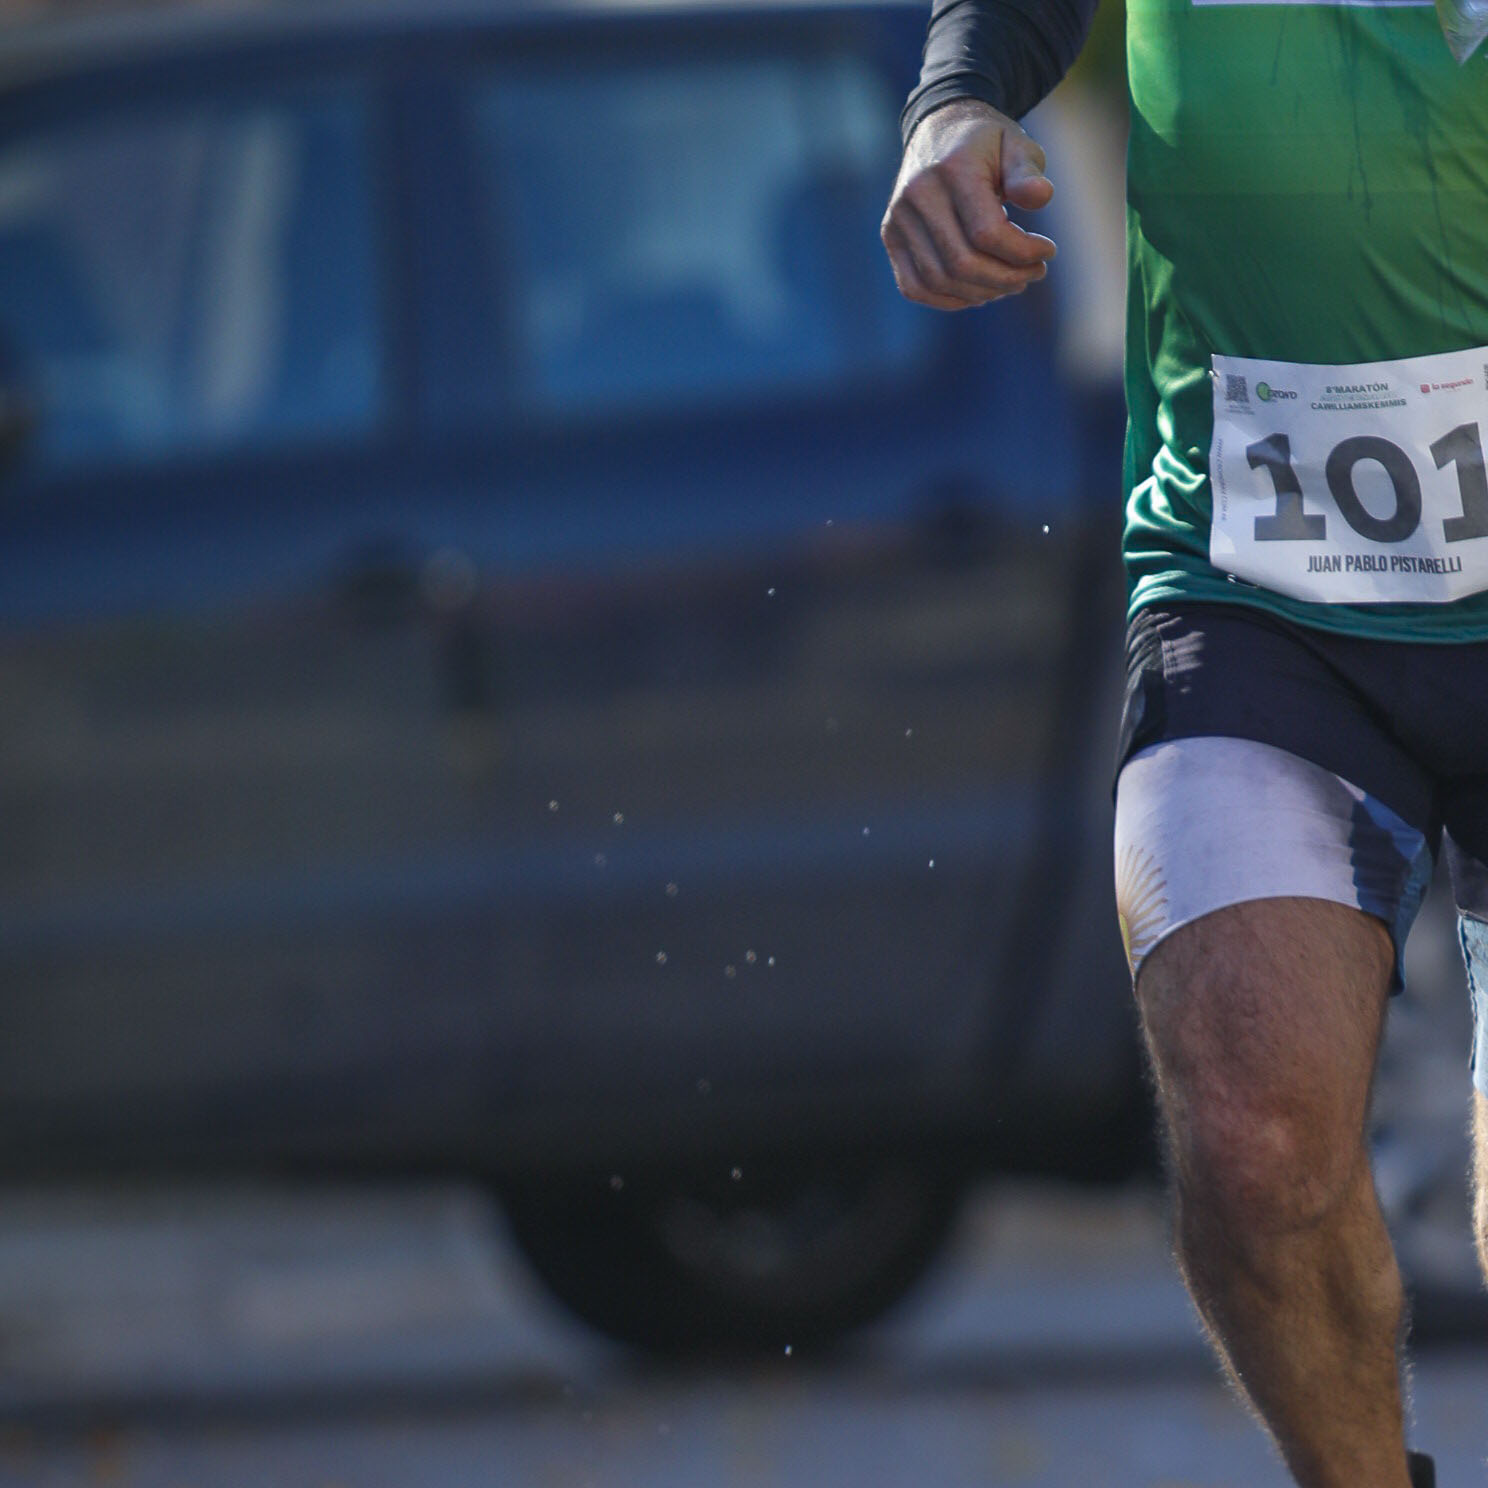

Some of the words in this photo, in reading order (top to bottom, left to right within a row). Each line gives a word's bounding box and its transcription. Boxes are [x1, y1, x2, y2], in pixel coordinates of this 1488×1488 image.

[1307, 555, 1342, 573] JUAN
[1345, 555, 1389, 573] PABLO
[1391, 555, 1463, 575] PISTARELLI
